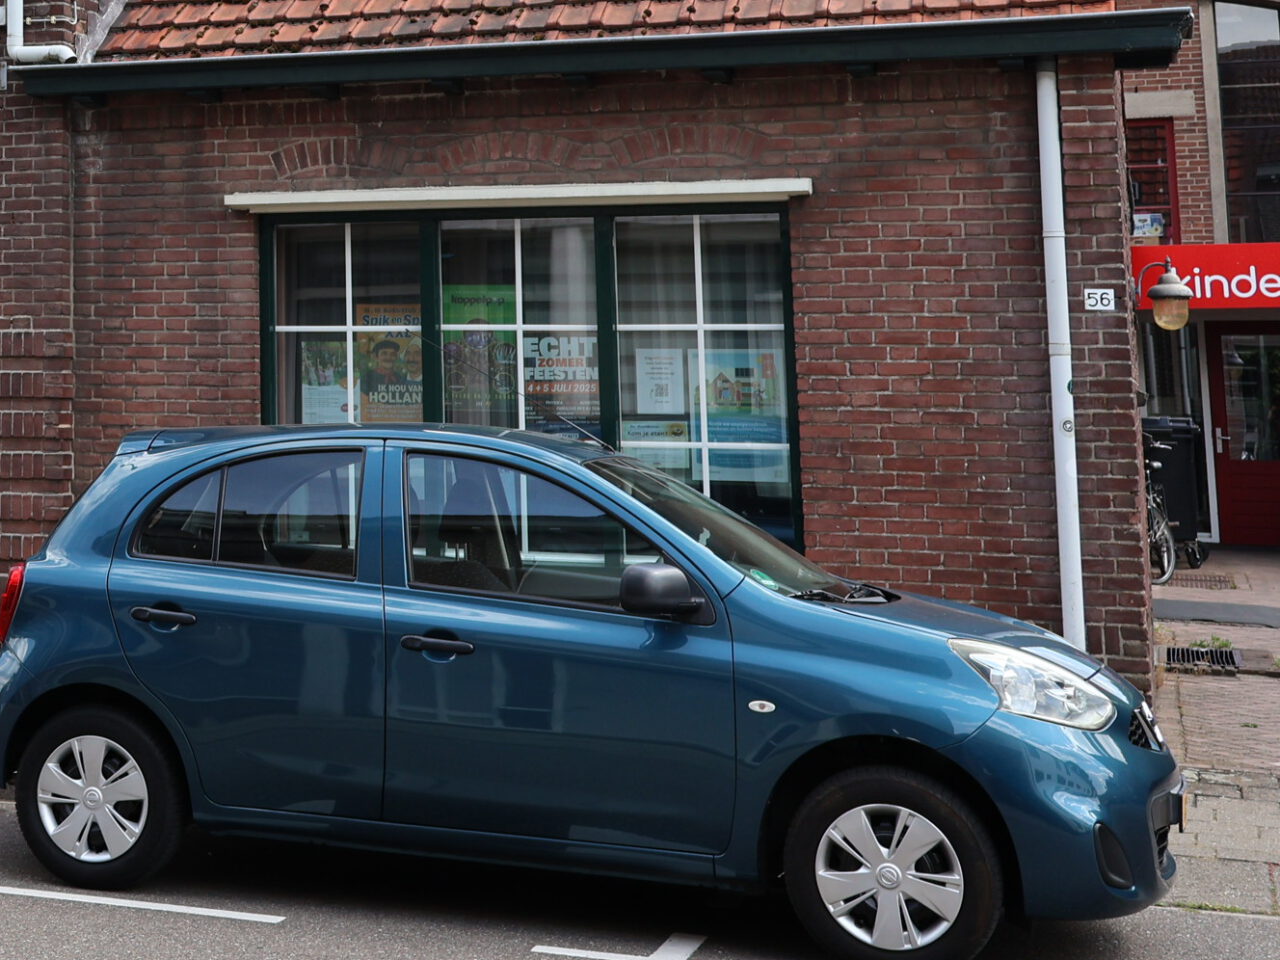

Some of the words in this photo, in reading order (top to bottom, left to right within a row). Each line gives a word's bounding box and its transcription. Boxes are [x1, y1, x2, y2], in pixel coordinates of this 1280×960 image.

[1086, 292, 1112, 308] 56
[523, 336, 598, 358] ECHT
[537, 358, 585, 368] ZOMER
[524, 368, 600, 381] FEESTEN
[378, 384, 387, 392] IK
[388, 384, 406, 392] HOU
[527, 384, 534, 392] 4
[543, 384, 550, 392] 5
[551, 383, 572, 392] JULI
[574, 383, 596, 392] 2025
